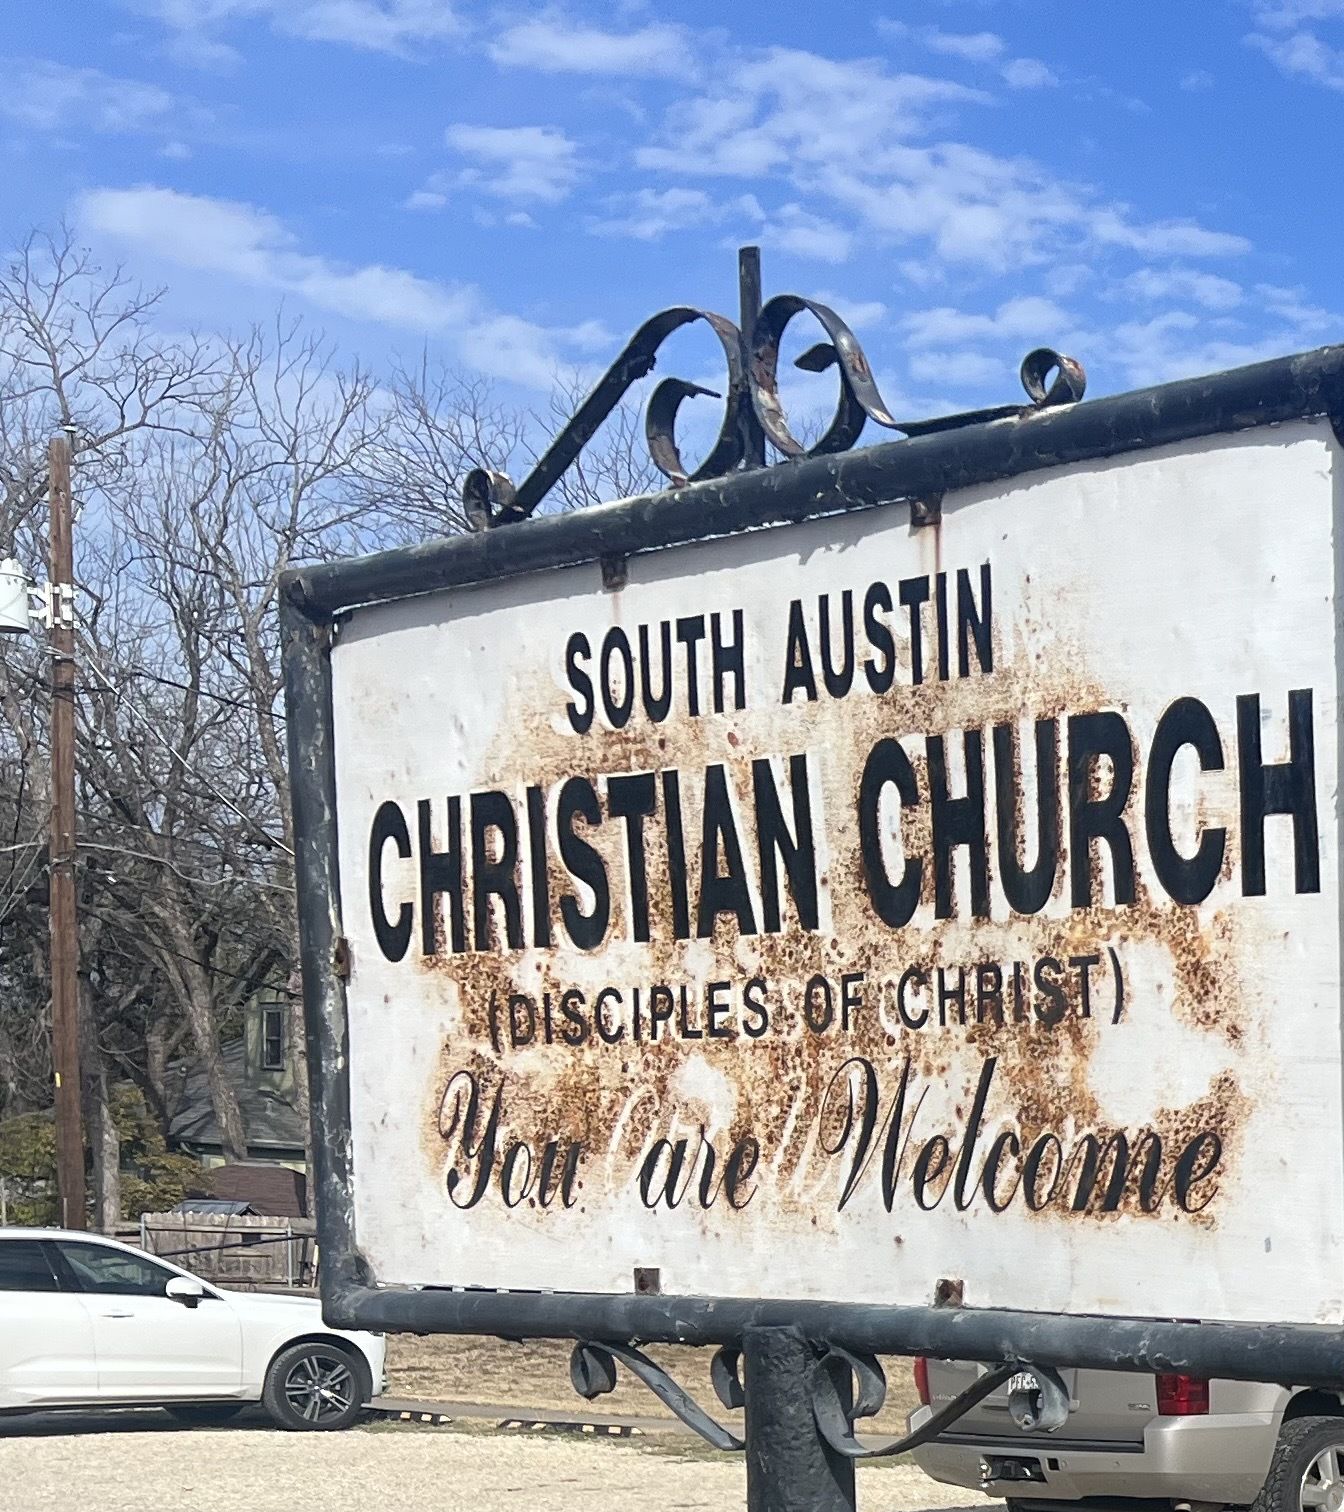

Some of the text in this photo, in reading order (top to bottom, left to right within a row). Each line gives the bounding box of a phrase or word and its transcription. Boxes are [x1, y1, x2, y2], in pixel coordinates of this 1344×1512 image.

[565, 563, 995, 735] SOUTH AUSTIN
[368, 688, 1321, 963] CHRISTIAN CHURCH
[488, 946, 1125, 1051] (DISCIPLES OF CHRIST)
[438, 1056, 1222, 1214] You are Welcome
